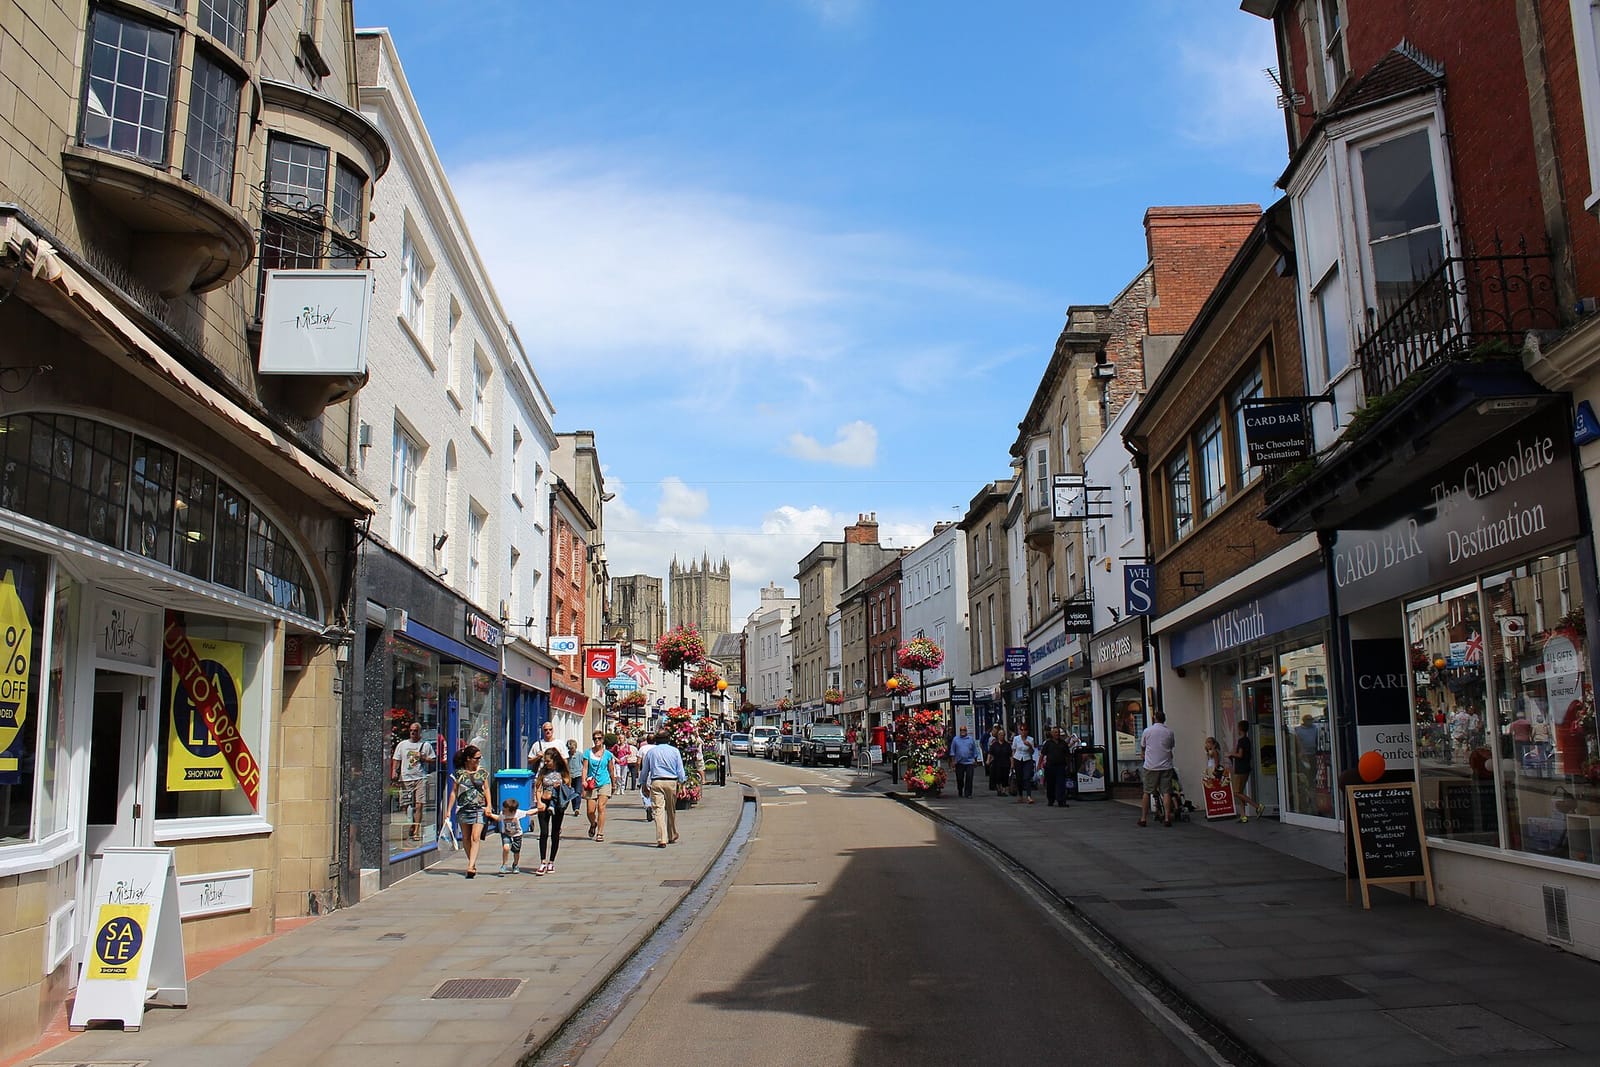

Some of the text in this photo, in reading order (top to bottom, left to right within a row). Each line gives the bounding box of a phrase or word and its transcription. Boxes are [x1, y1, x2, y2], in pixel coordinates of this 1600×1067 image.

[1246, 413, 1301, 427] CARD BAR
[1248, 438, 1305, 451] The Chocolate
[1256, 448, 1301, 461] Destination
[1430, 435, 1555, 519] The Chocolate
[1447, 501, 1547, 565] Destination
[1335, 518, 1424, 588] CARD BAR
[1129, 568, 1150, 579] WH
[1129, 578, 1152, 612] S
[1212, 599, 1266, 653] WHSmith
[1098, 641, 1112, 663] vision
[1, 680, 26, 699] OFF
[164, 622, 190, 658] UP
[185, 657, 210, 702] TO
[206, 702, 240, 753] 50%
[187, 769, 220, 778] SHOP NOW
[1353, 790, 1382, 798] Card
[106, 922, 134, 941] SA
[104, 941, 130, 960] LE
